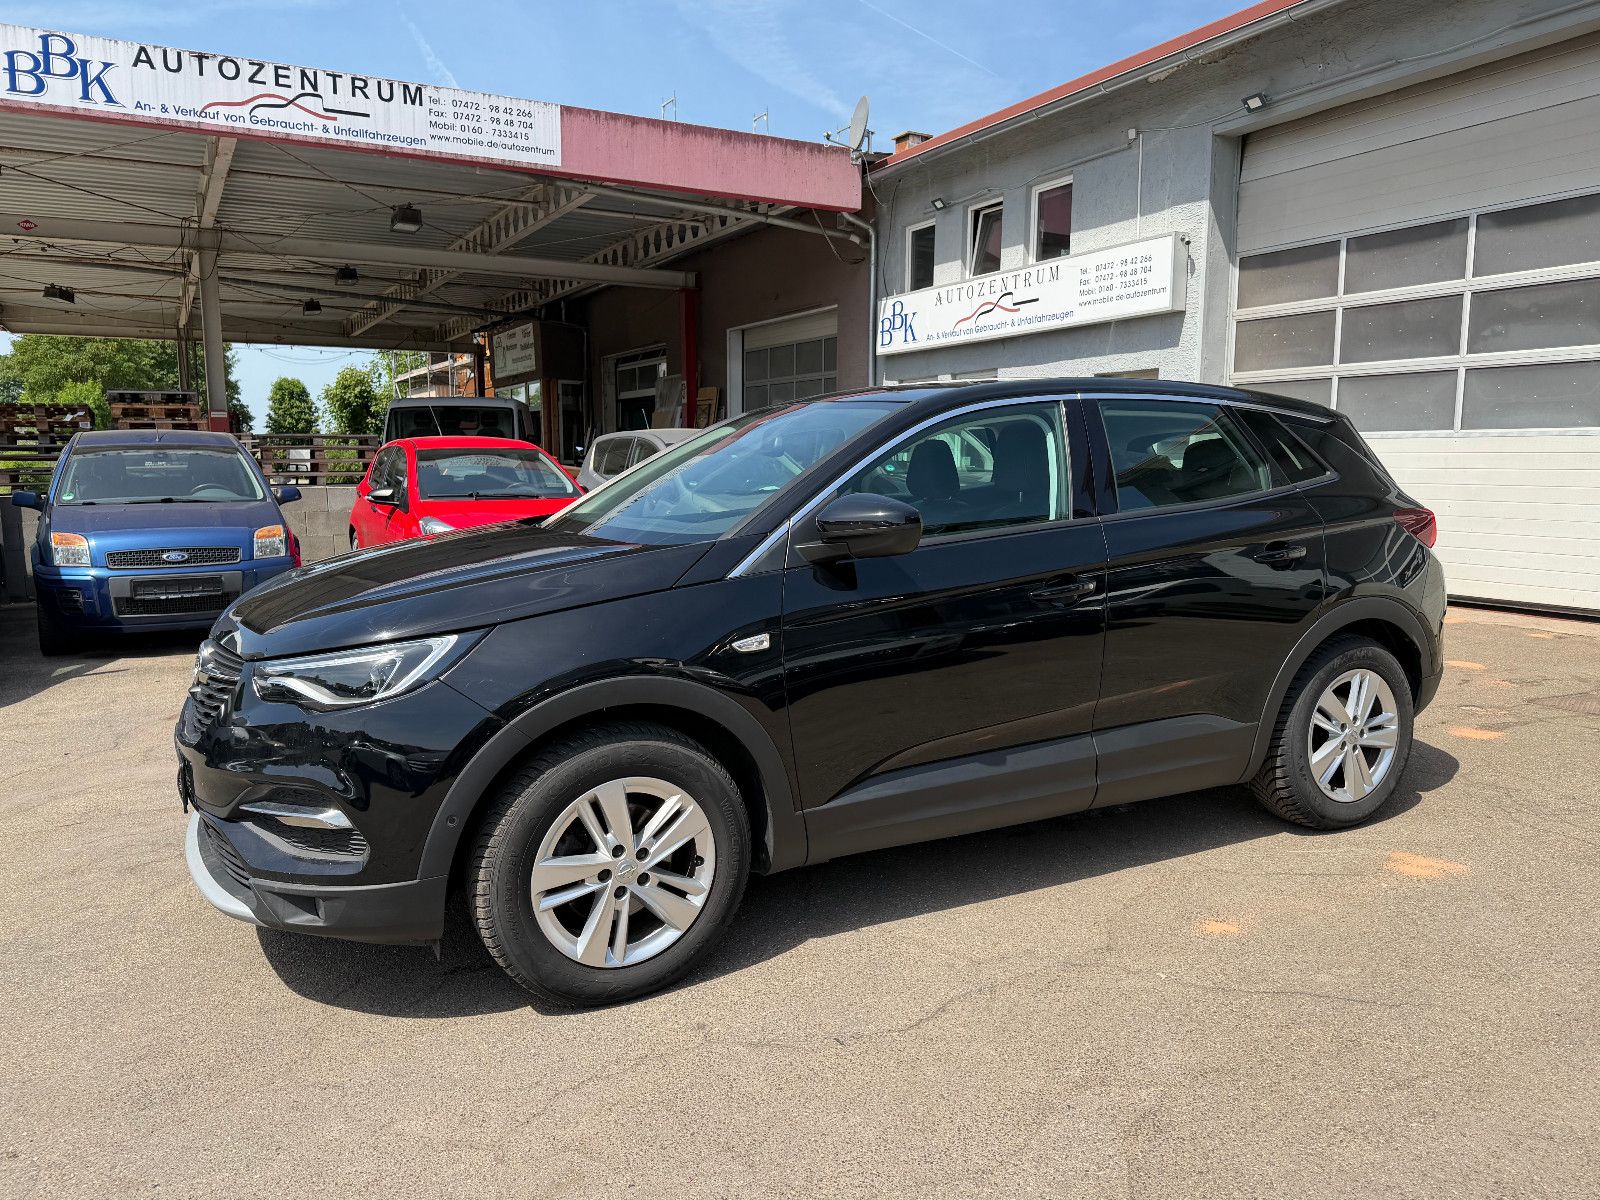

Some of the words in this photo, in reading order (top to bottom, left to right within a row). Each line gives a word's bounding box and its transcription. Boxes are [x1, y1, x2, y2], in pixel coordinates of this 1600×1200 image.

[2, 33, 126, 108] BBK
[132, 46, 423, 106] AUTOZENTRUM
[428, 95, 446, 106] Tel.:
[451, 99, 480, 110] 07472
[488, 104, 500, 113] 98
[502, 106, 514, 116] 42
[516, 108, 533, 118] 266
[134, 100, 156, 112] An-
[160, 103, 170, 114] &
[173, 105, 220, 121] Verkauf
[223, 113, 246, 124] von
[250, 114, 318, 132] Gebraucht-
[321, 124, 331, 134] &
[333, 125, 427, 146] Unfallfahrzeugen
[428, 108, 447, 118] Fax:
[453, 111, 481, 123] 07472
[489, 116, 501, 126] 98
[503, 118, 515, 127] 48
[517, 120, 533, 130] 704
[429, 120, 457, 132] Mobil:
[460, 124, 483, 134] 0160
[491, 128, 530, 141] 7333415
[429, 133, 555, 156] www.mobile.de/autozentrum
[1129, 256, 1138, 265] 42
[934, 264, 1061, 307] AUTOZENTRUM
[880, 300, 919, 348] BBK
[1010, 318, 1016, 328] &
